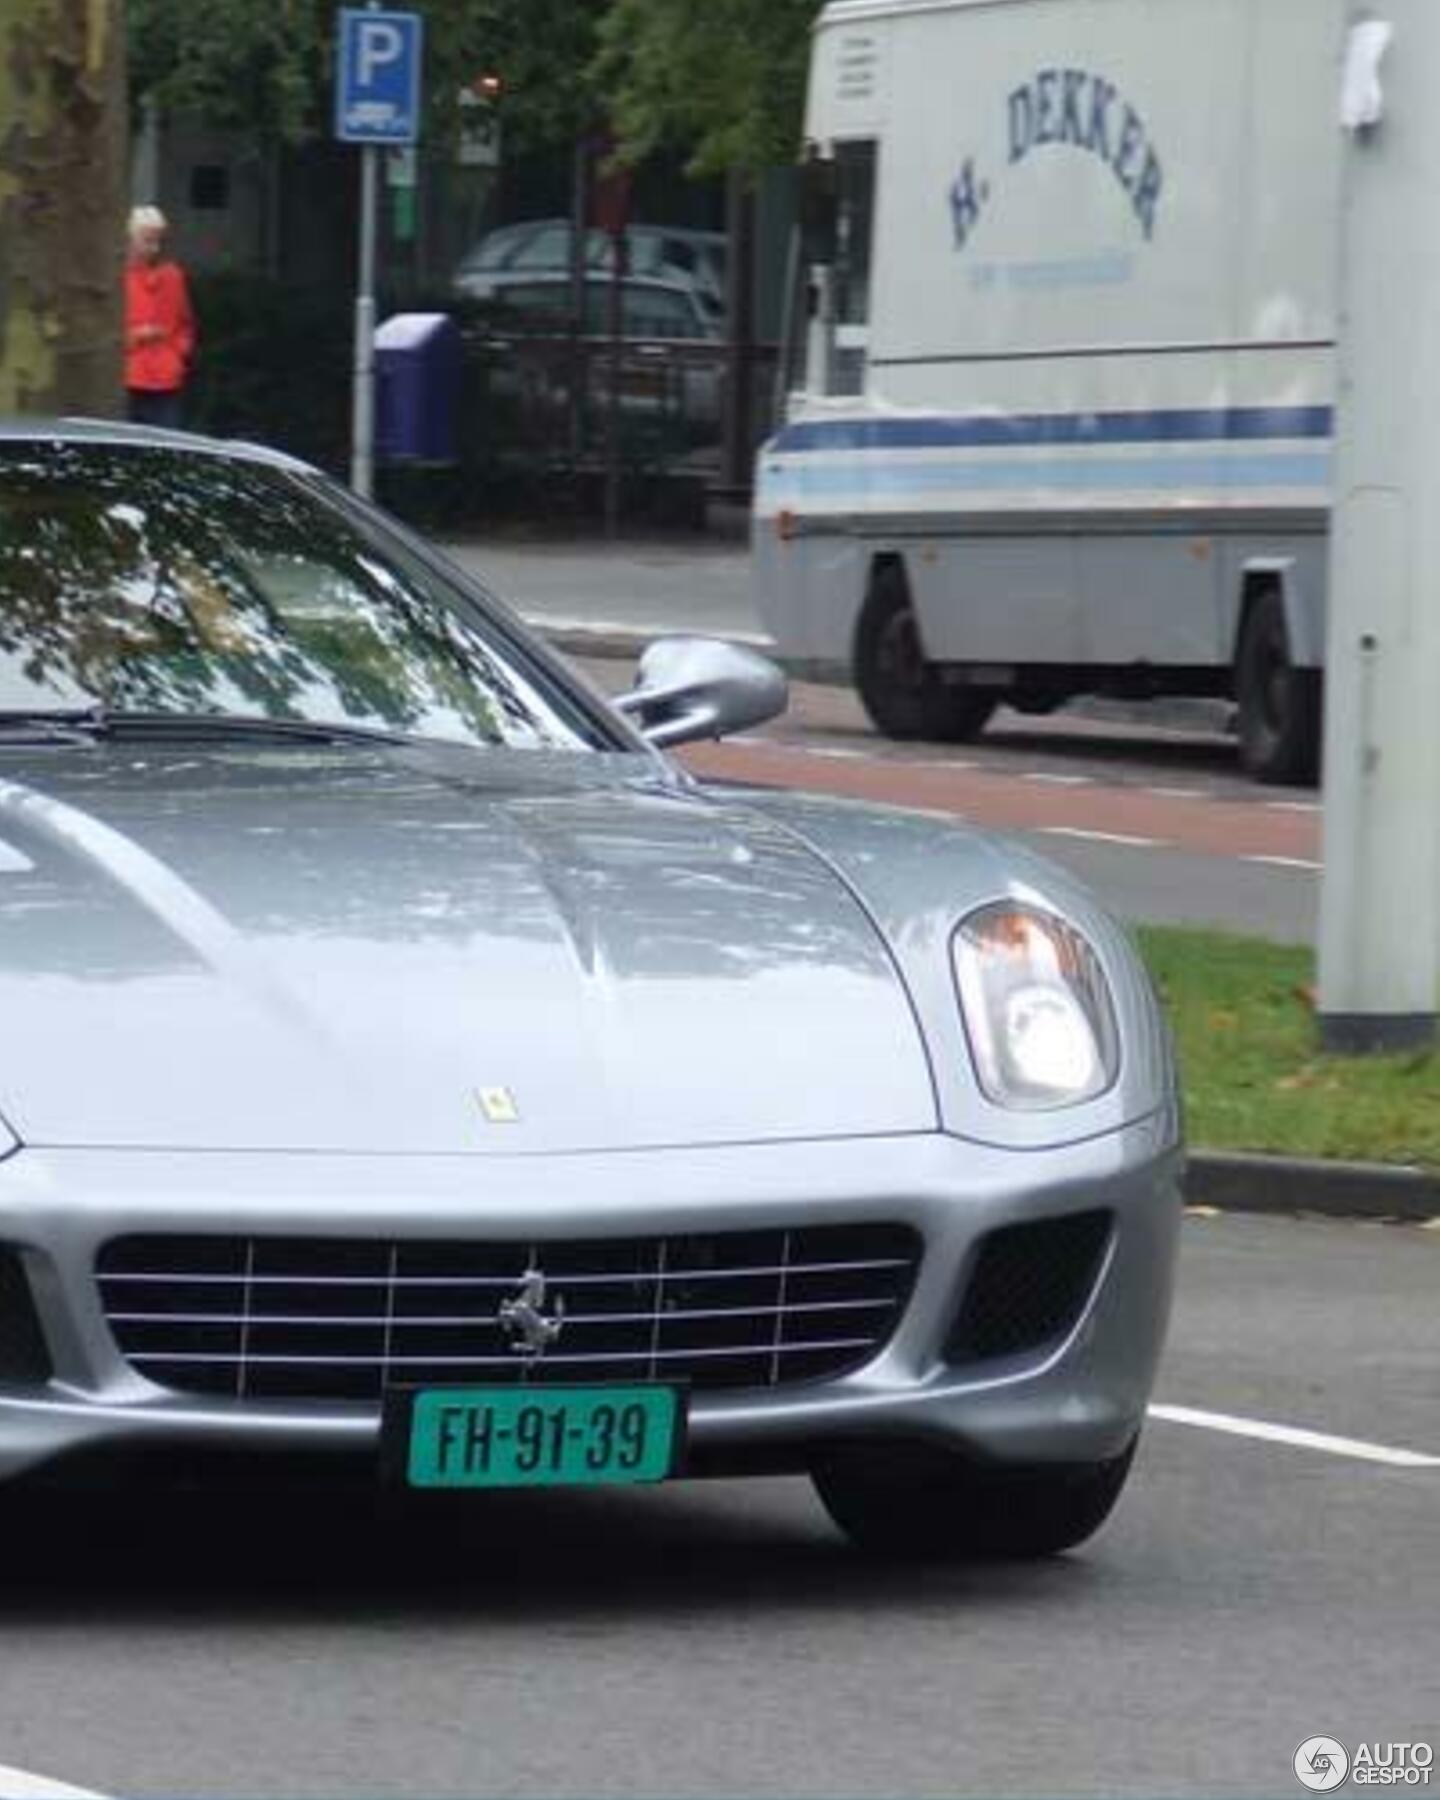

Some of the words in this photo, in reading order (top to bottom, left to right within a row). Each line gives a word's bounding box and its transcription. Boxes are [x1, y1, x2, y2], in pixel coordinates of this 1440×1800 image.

[358, 22, 402, 86] P
[950, 156, 990, 251] H.
[1008, 69, 1162, 242] DEKKER
[437, 1403, 646, 1473] FH-91-39
